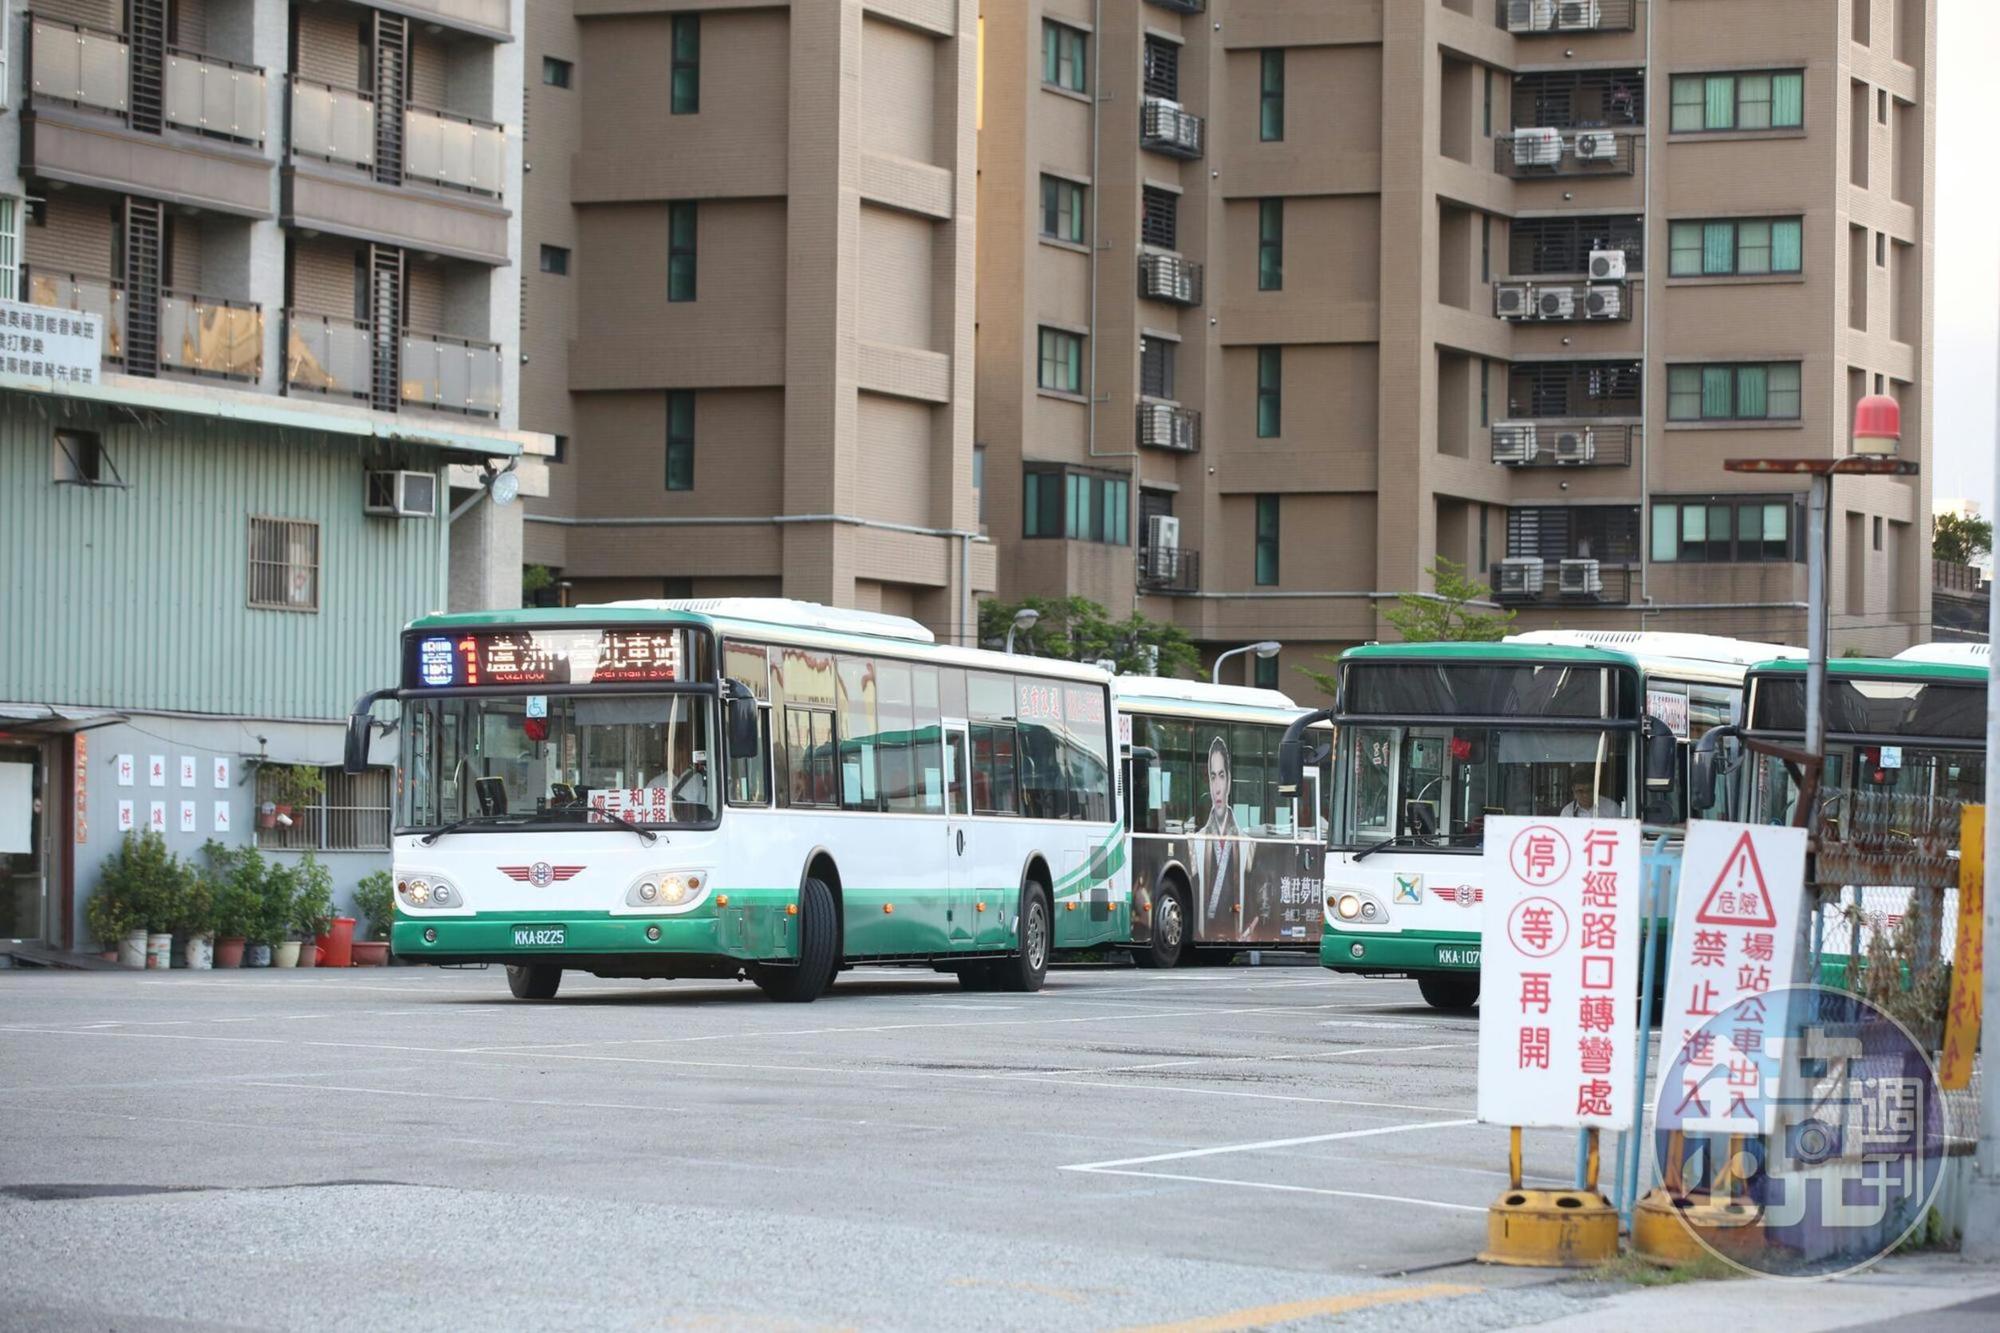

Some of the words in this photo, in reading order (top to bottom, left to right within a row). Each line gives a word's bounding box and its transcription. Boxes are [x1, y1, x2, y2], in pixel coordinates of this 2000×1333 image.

[608, 785, 666, 806] 三和路
[1280, 876, 1323, 904] 邀君夢回
[1517, 834, 1557, 1070] 停等再開
[1576, 829, 1619, 1116] 行經路口轉彎處
[1716, 891, 1759, 916] 危險
[1675, 930, 1727, 1116] 禁止進入
[1722, 932, 1774, 1118] 場站公車出入
